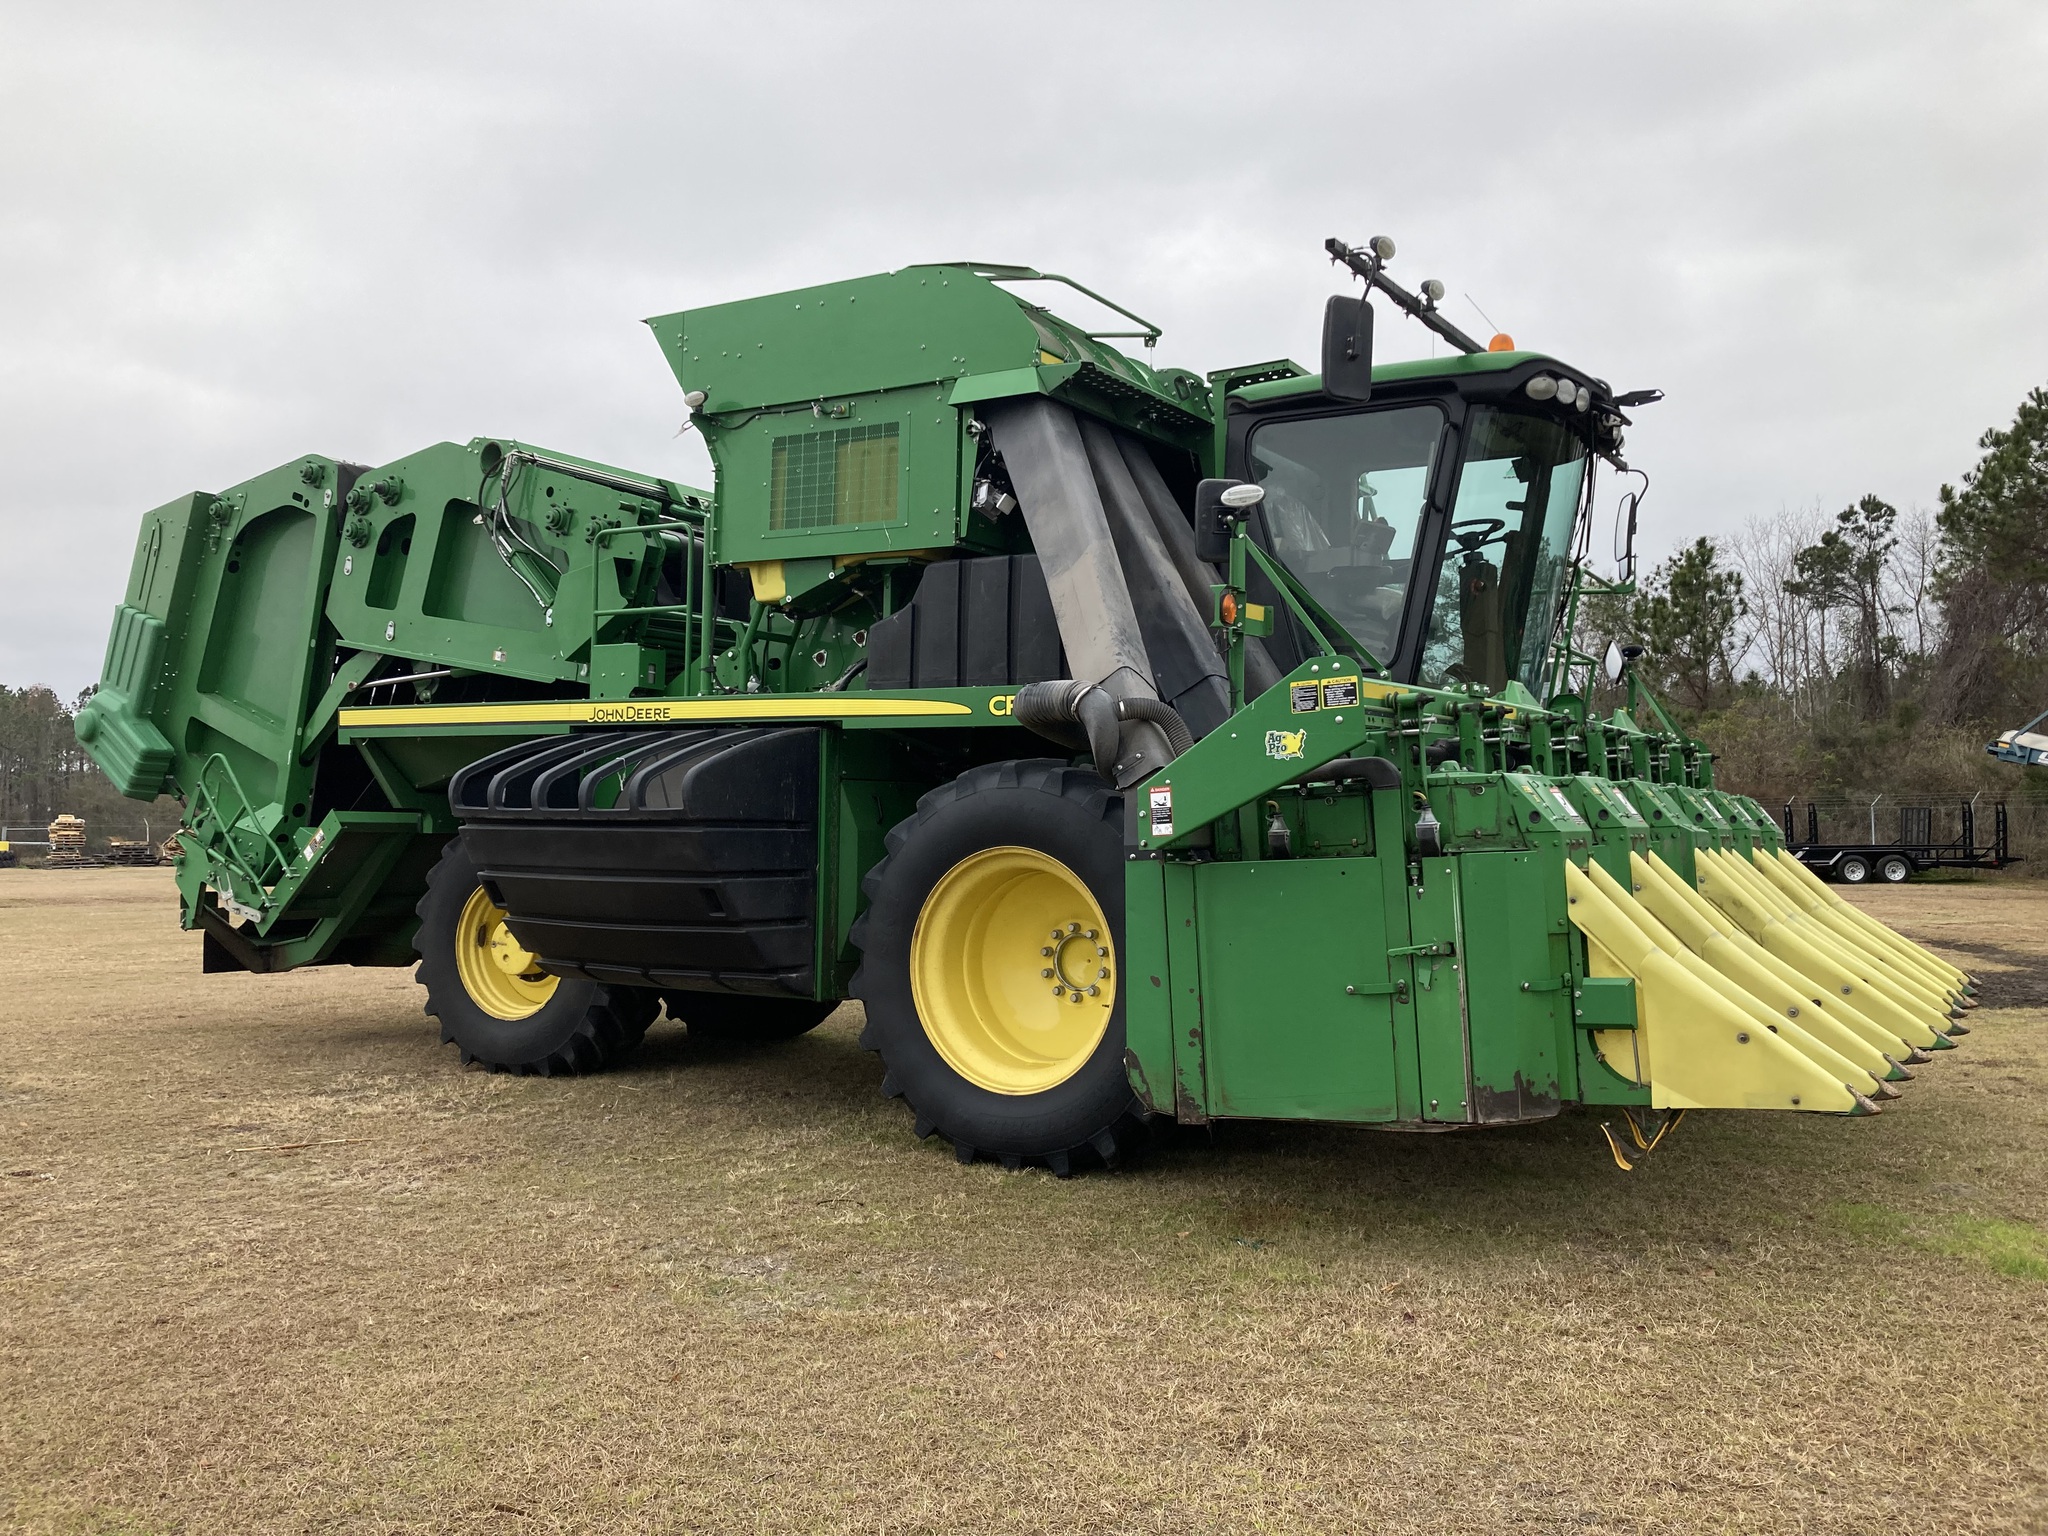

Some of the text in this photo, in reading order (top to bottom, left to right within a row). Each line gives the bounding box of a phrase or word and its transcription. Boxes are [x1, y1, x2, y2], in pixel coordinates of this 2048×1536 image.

[588, 706, 671, 721] JOHN DEERE
[1268, 743, 1287, 754] Pro
